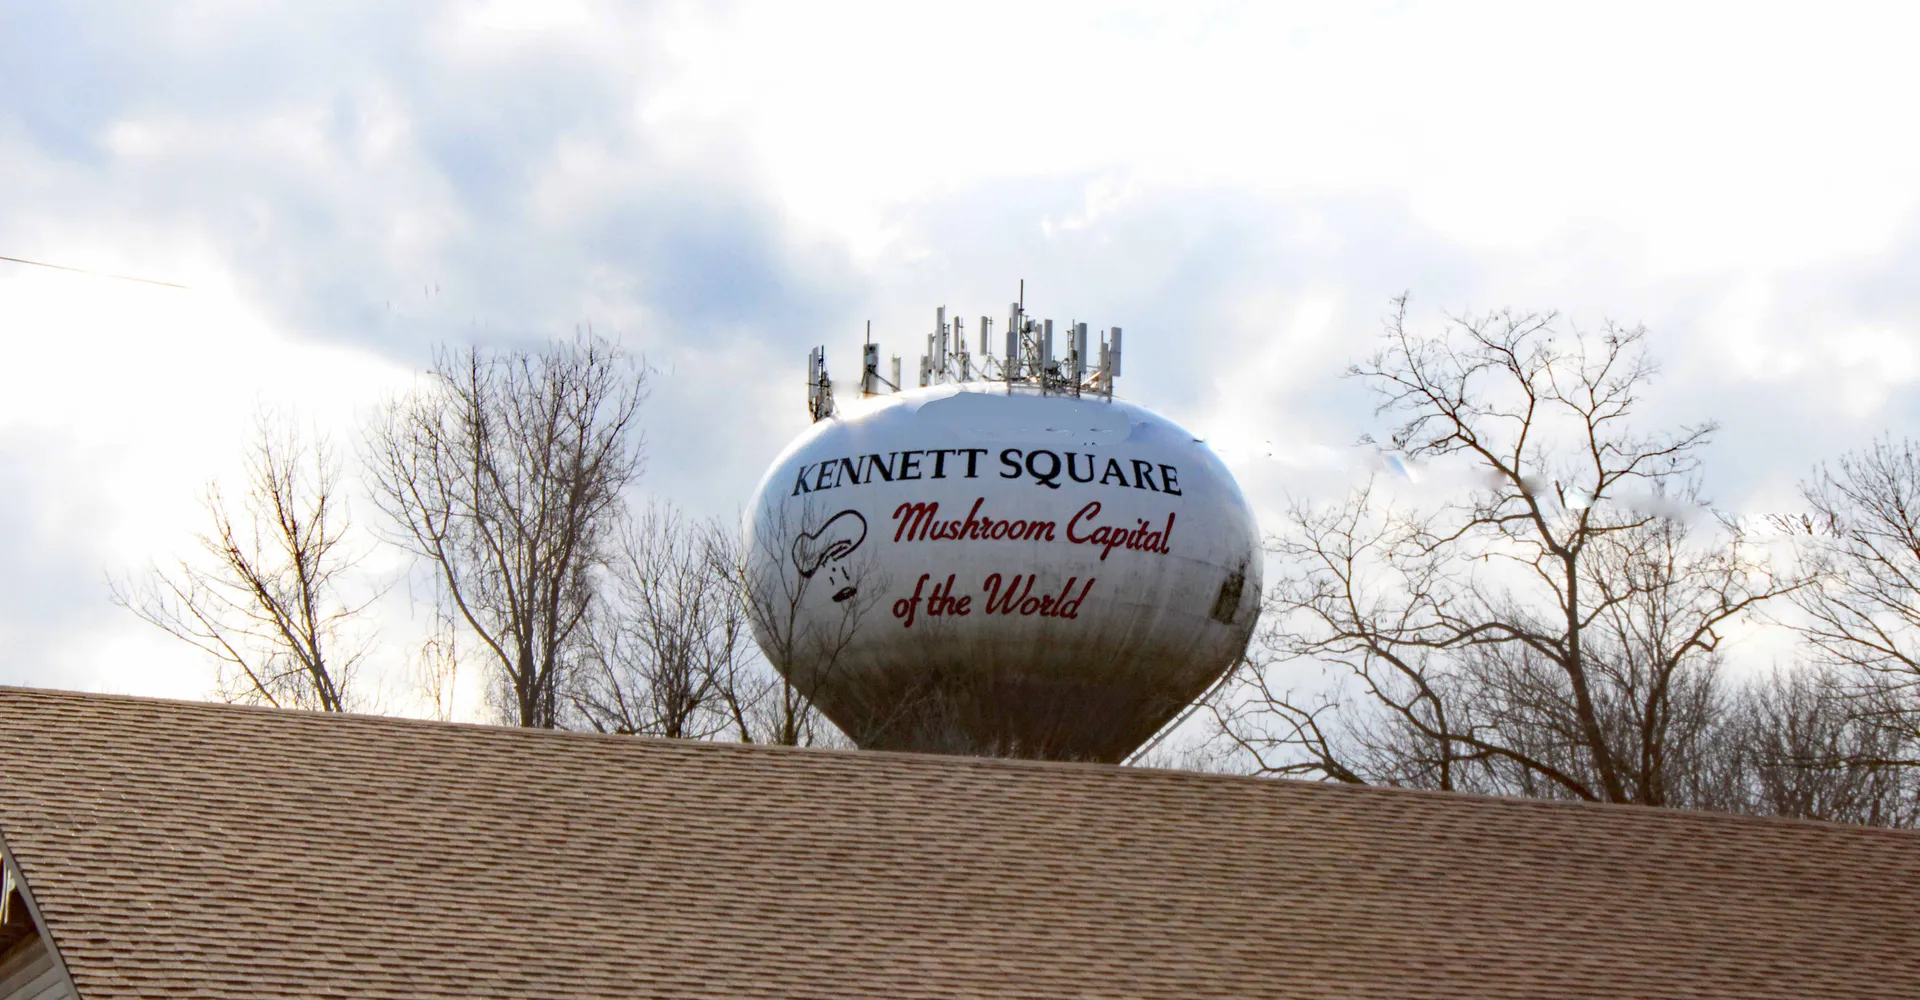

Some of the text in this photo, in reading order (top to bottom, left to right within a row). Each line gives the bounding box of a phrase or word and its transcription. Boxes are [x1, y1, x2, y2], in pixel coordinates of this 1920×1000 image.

[791, 448, 1182, 496] KENNETT SQUARE
[891, 497, 1176, 560] Mushroom Capital
[893, 573, 1095, 627] of the World
